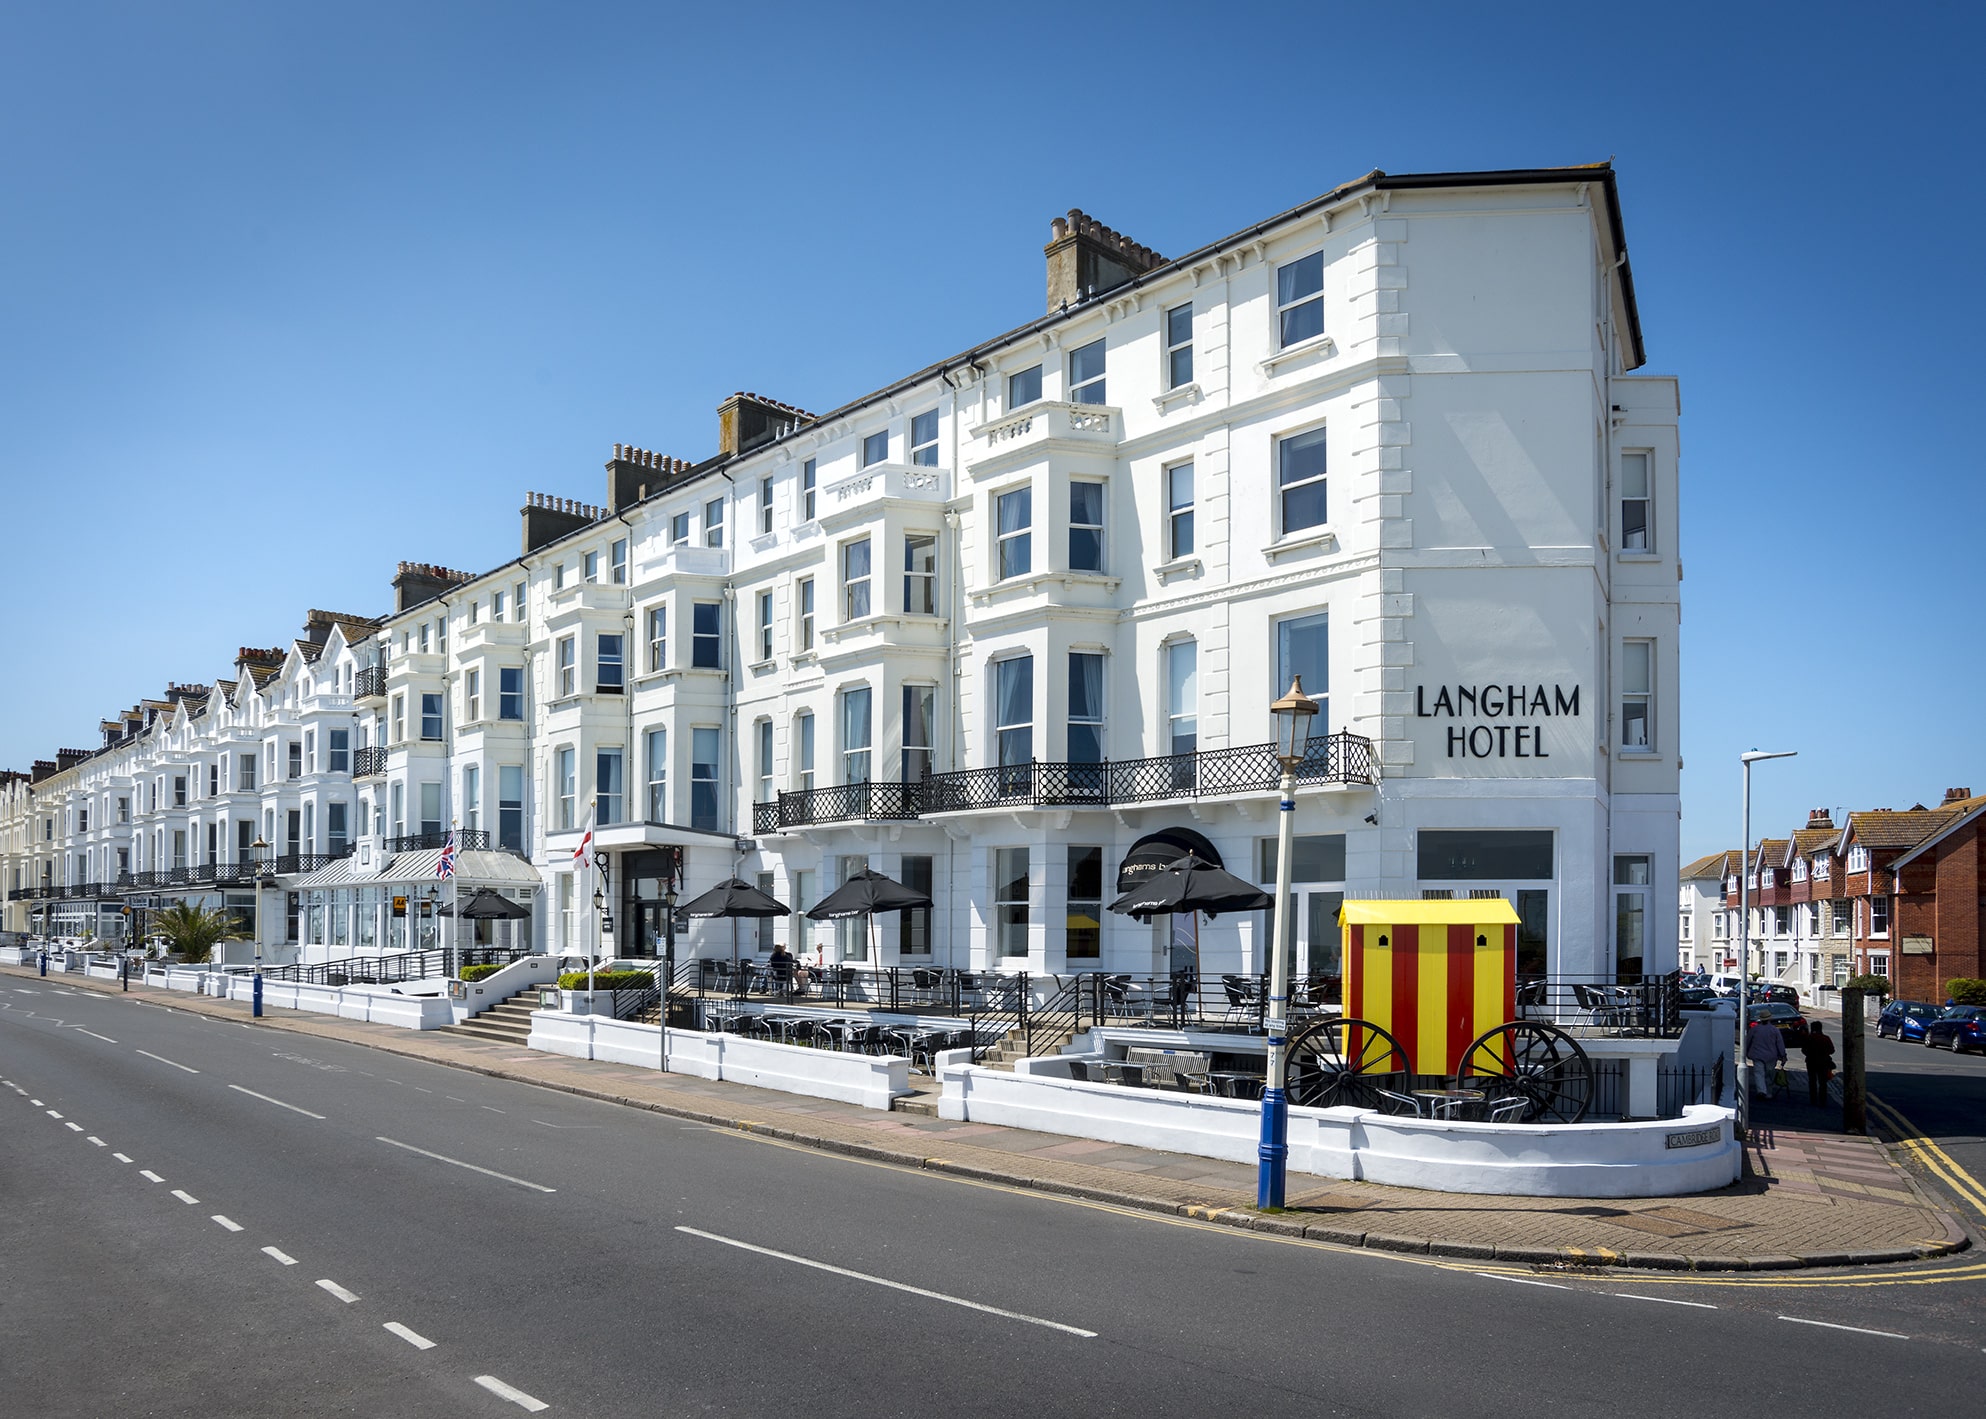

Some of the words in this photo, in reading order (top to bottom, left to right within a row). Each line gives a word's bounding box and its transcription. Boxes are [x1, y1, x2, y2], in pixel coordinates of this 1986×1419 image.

[1417, 684, 1580, 717] LANGHAM
[1447, 725, 1549, 758] HOTEL
[1670, 1132, 1708, 1146] CAMBRIDGE
